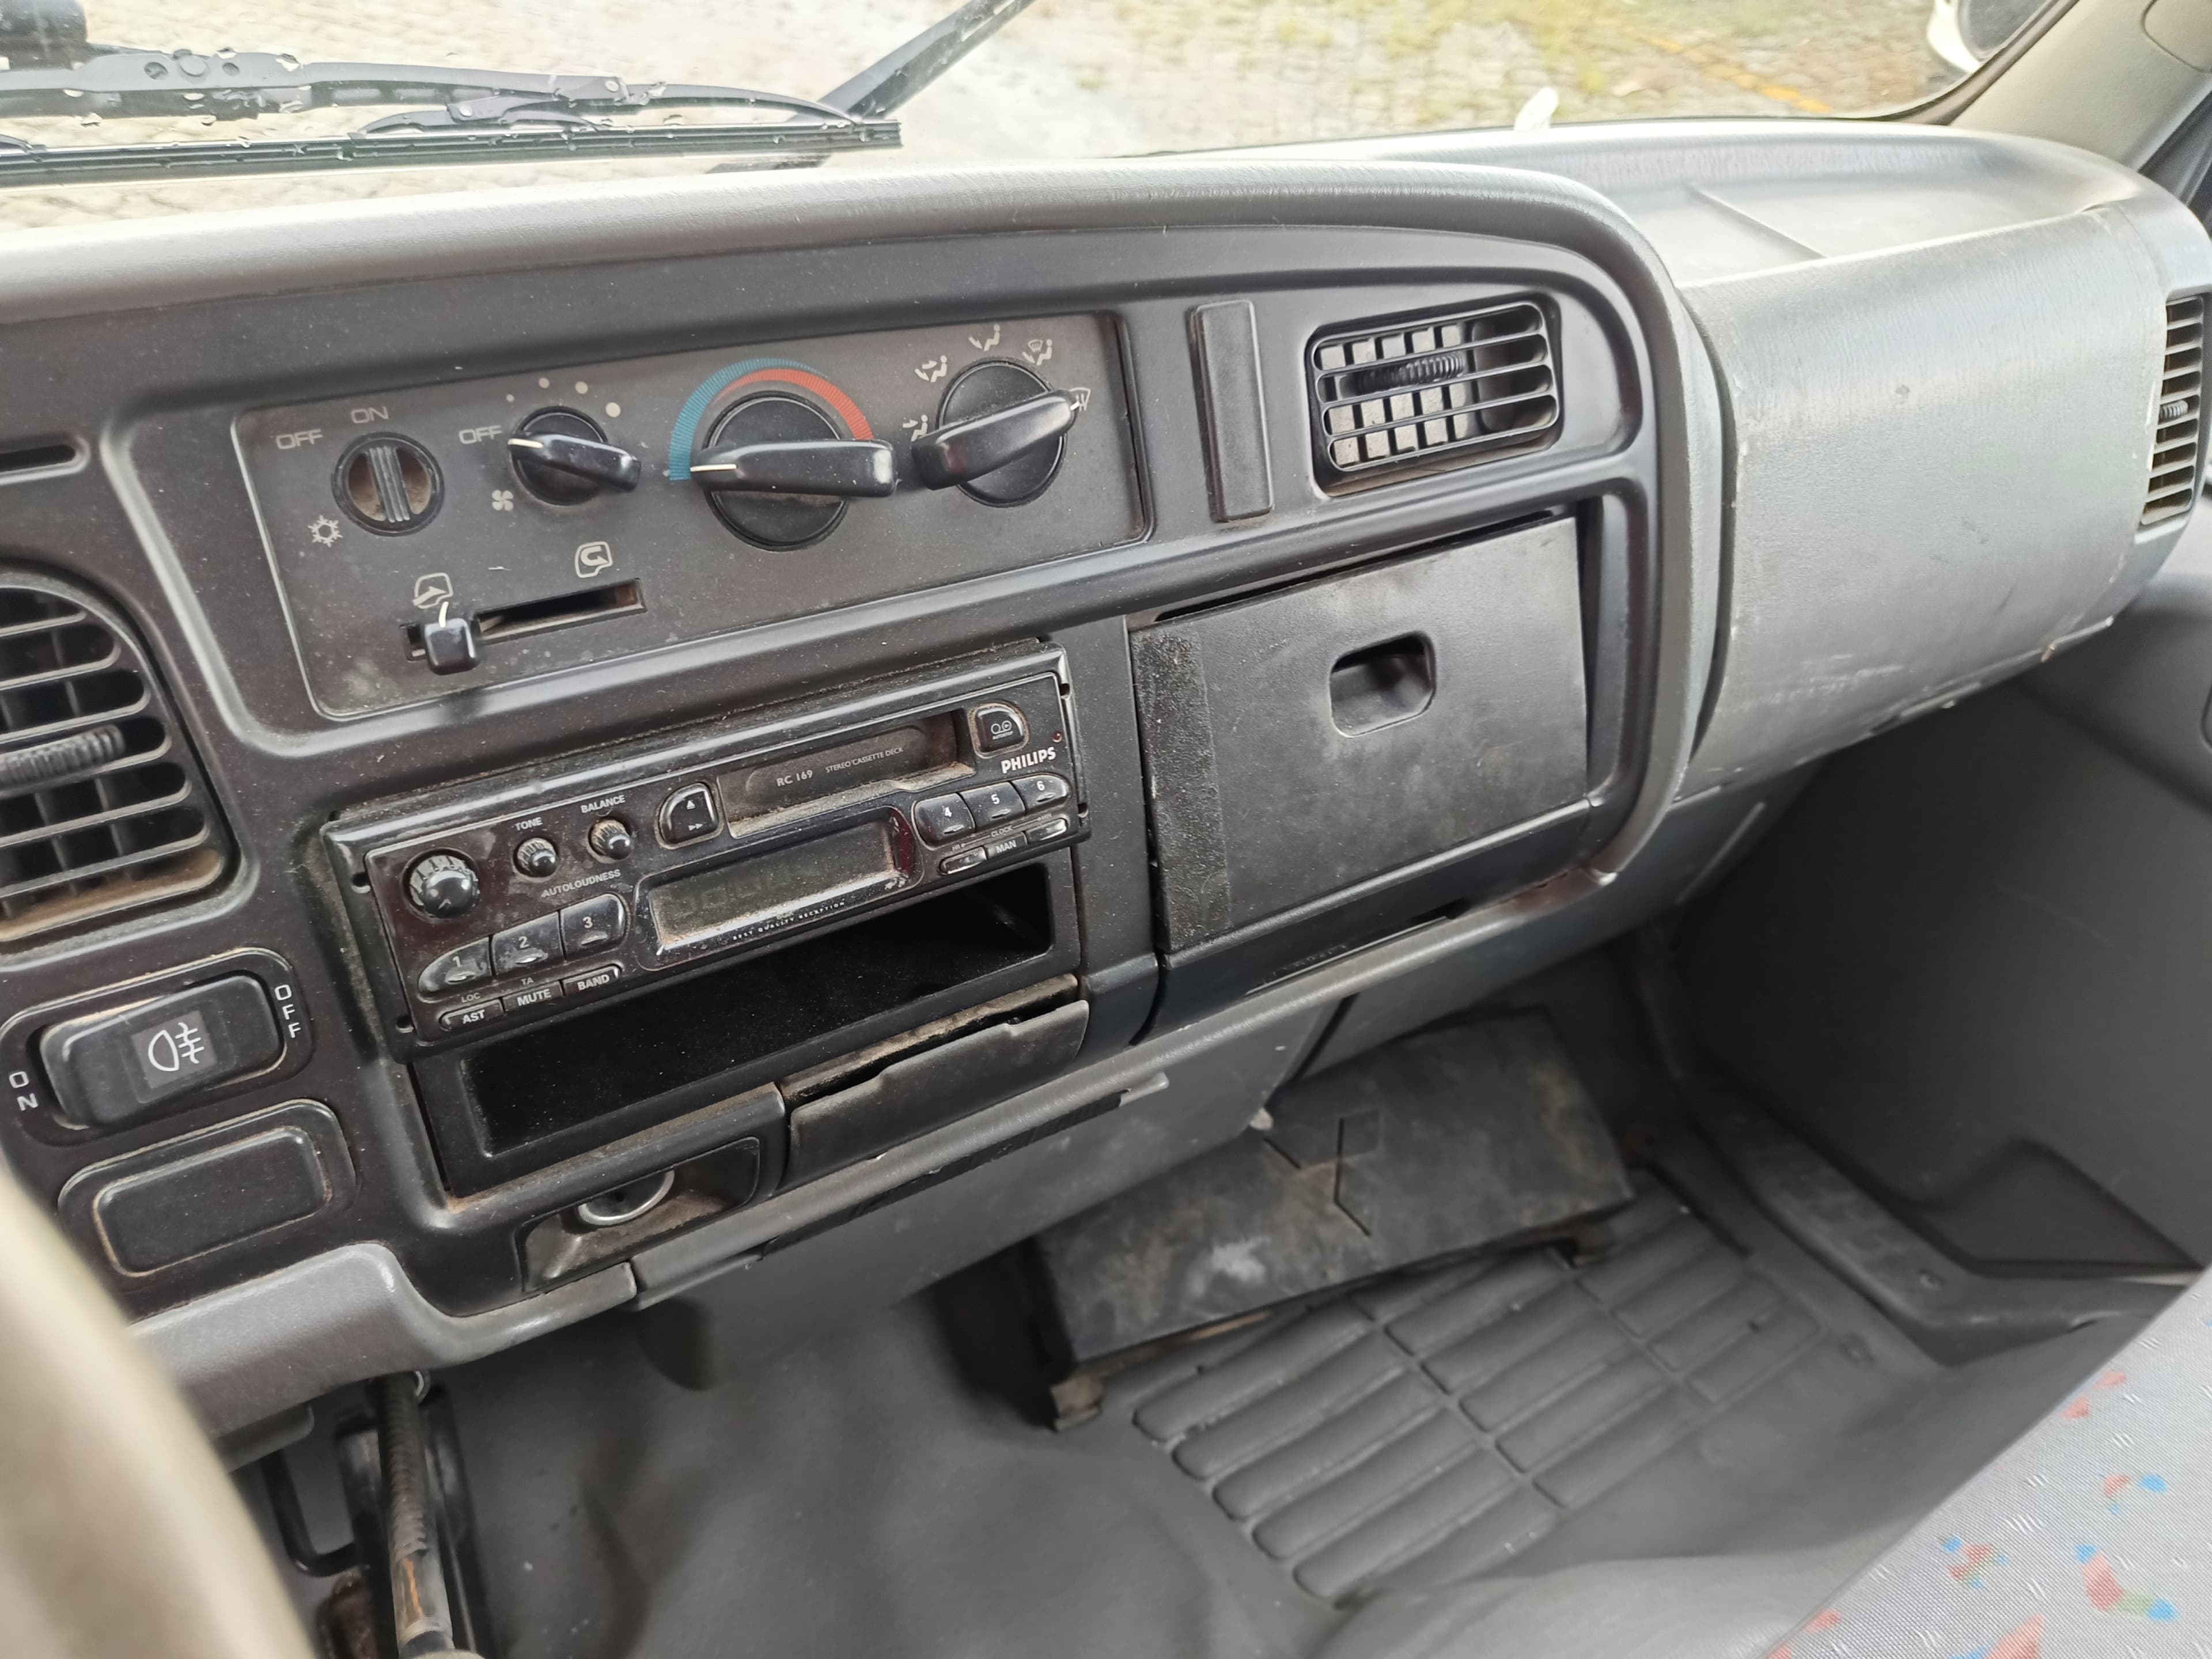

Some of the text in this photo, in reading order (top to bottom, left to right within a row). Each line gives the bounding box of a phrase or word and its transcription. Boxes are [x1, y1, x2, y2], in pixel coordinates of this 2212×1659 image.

[351, 406, 389, 424] ON
[276, 429, 323, 449] OFF
[459, 425, 502, 444] OFF
[825, 747, 903, 773] STEREO CASSETTE DECK
[1001, 747, 1056, 774] PHILIPS
[777, 770, 813, 787] RC 169
[1037, 781, 1046, 790] 6
[581, 795, 626, 813] BALANCE
[991, 794, 1000, 804] 5
[945, 807, 952, 817] 4
[515, 817, 543, 831] TONE
[991, 825, 1013, 837] CLOCK
[996, 840, 1016, 853] MAN
[541, 869, 621, 897] AUTOLOUDNESS
[583, 916, 593, 929] 3
[758, 917, 794, 932] QUALITY
[519, 936, 529, 949] 2
[453, 956, 461, 968] 1
[521, 977, 534, 986] TA
[577, 974, 609, 991] BAND
[461, 993, 480, 1003] LOC
[517, 988, 551, 1006] MUTE
[274, 984, 302, 1039] OFF
[463, 1010, 485, 1024] AST
[9, 1071, 39, 1111] ON
